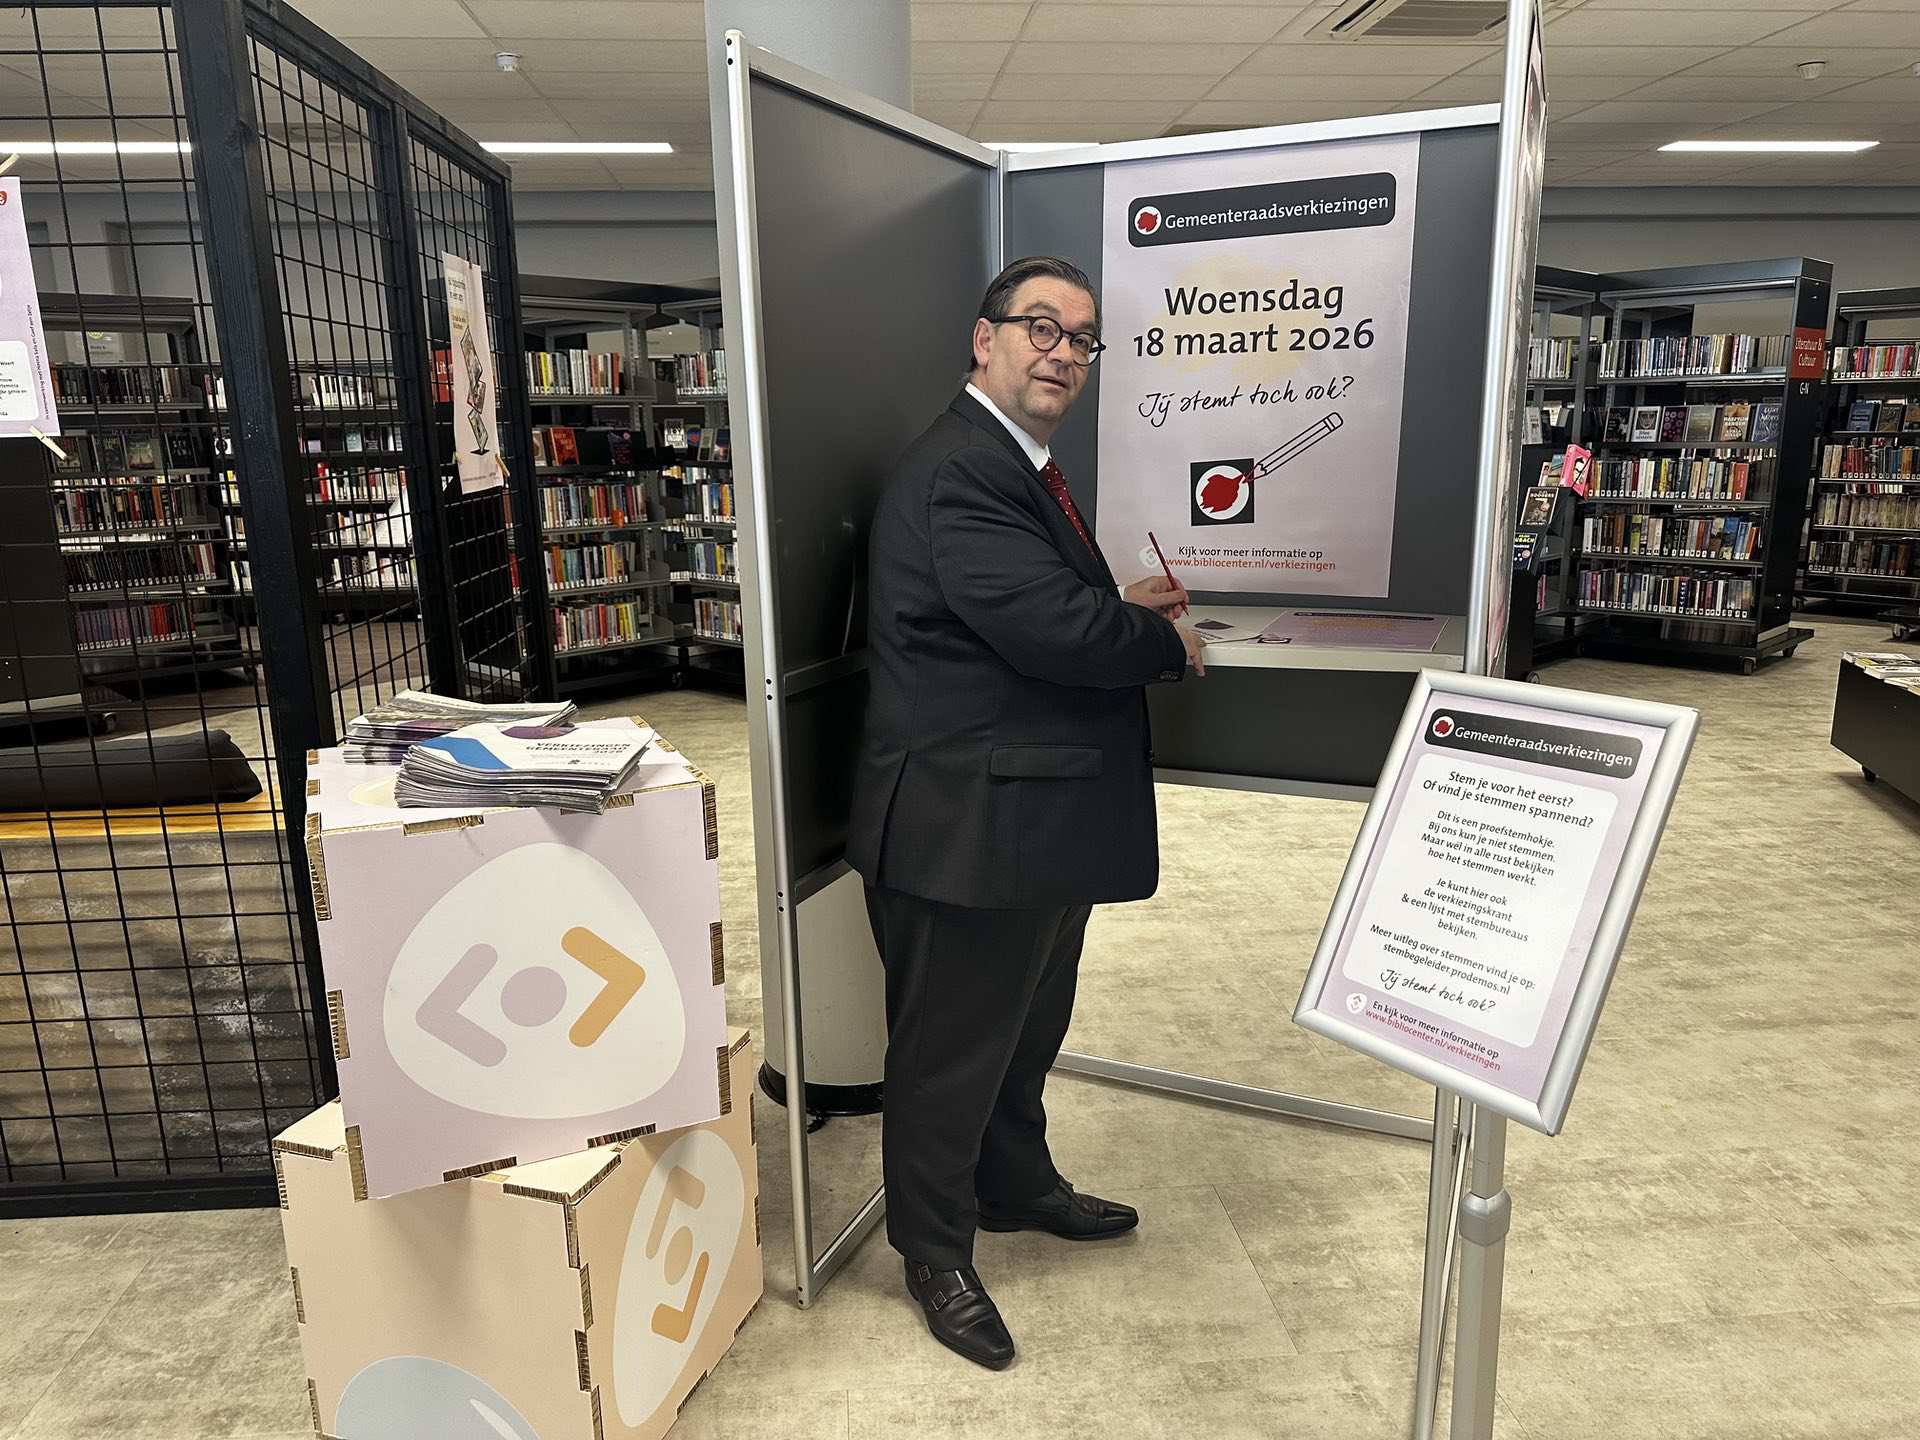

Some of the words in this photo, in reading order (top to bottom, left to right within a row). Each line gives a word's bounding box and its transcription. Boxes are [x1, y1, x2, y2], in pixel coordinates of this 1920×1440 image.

[1165, 196, 1388, 229] Gemeenteraadsverkiezingen
[1164, 278, 1343, 319] Woensdag
[1133, 327, 1164, 357] 18
[1173, 323, 1278, 356] maart
[1288, 315, 1374, 351] 2026
[1138, 392, 1175, 428] Jij
[1179, 384, 1243, 412] stemt
[1249, 379, 1298, 405] toch
[1304, 375, 1354, 400] ook?
[1165, 556, 1336, 572] www.bibliocenter.nl/verkiezingen
[1178, 545, 1197, 558] Kijk
[1199, 548, 1221, 556] voor
[1222, 549, 1249, 557] meer
[1251, 547, 1307, 558] informatie
[1308, 550, 1323, 559] op
[1454, 726, 1632, 766] Gemeenteraadsverkiezingen
[1422, 779, 1438, 790] Of
[1437, 783, 1461, 797] vind
[1459, 788, 1473, 801] je
[1473, 792, 1527, 813] stemmen
[1528, 806, 1594, 828] spannend?
[1448, 770, 1476, 786] Stem
[1475, 777, 1489, 790] je
[1490, 782, 1516, 794] voor
[1516, 785, 1536, 800] het
[1537, 793, 1574, 808] eerst?
[1427, 821, 1441, 834] Bij
[1441, 826, 1457, 836] ons
[1458, 828, 1476, 841] kun
[1475, 833, 1487, 845] je
[1488, 838, 1507, 850] niet
[1508, 843, 1556, 862] stemmen.
[1437, 810, 1451, 821] Dit
[1452, 815, 1460, 823] is
[1460, 818, 1478, 828] een
[1478, 822, 1555, 849] proefstemhokje.
[1420, 832, 1445, 846] Maar
[1463, 845, 1473, 854] in
[1473, 847, 1491, 859] alle
[1492, 853, 1512, 865] rust
[1512, 856, 1554, 876] bekijken
[1427, 846, 1445, 860] hoe
[1445, 851, 1461, 864] het
[1461, 858, 1505, 877] stemmen
[1507, 871, 1536, 886] werkt.
[1423, 887, 1436, 898] de
[1437, 892, 1512, 922] verkiezingskrant
[1436, 877, 1446, 888] Je
[1446, 879, 1469, 894] kunt
[1469, 886, 1489, 900] hier
[1489, 895, 1507, 906] ook
[1400, 892, 1410, 903] &
[1410, 898, 1427, 909] een
[1427, 901, 1445, 915] lijst
[1446, 909, 1465, 921] met
[1466, 916, 1528, 942] stembureaus
[1437, 918, 1478, 940] bekijken.
[1369, 923, 1392, 938] Meer
[1393, 933, 1419, 950] uitleg
[1419, 943, 1440, 954] over
[1440, 950, 1484, 971] stemmen
[1486, 966, 1508, 979] vind
[1507, 974, 1518, 984] je
[1383, 943, 1511, 995] stembegeleider.prodemos.nl
[1379, 968, 1401, 990] Jij
[1401, 976, 1436, 994] stemt
[1438, 986, 1464, 1005] toch
[1467, 998, 1496, 1012] ook?
[1366, 1009, 1501, 1072] www.bibliocenter.nl/verkiezingen
[1372, 1000, 1383, 1011] En
[1383, 1004, 1399, 1018] kijk
[1399, 1013, 1417, 1025] voor
[1418, 1020, 1440, 1034] meer
[1440, 1029, 1486, 1053] informatie
[1486, 1049, 1499, 1060] op
